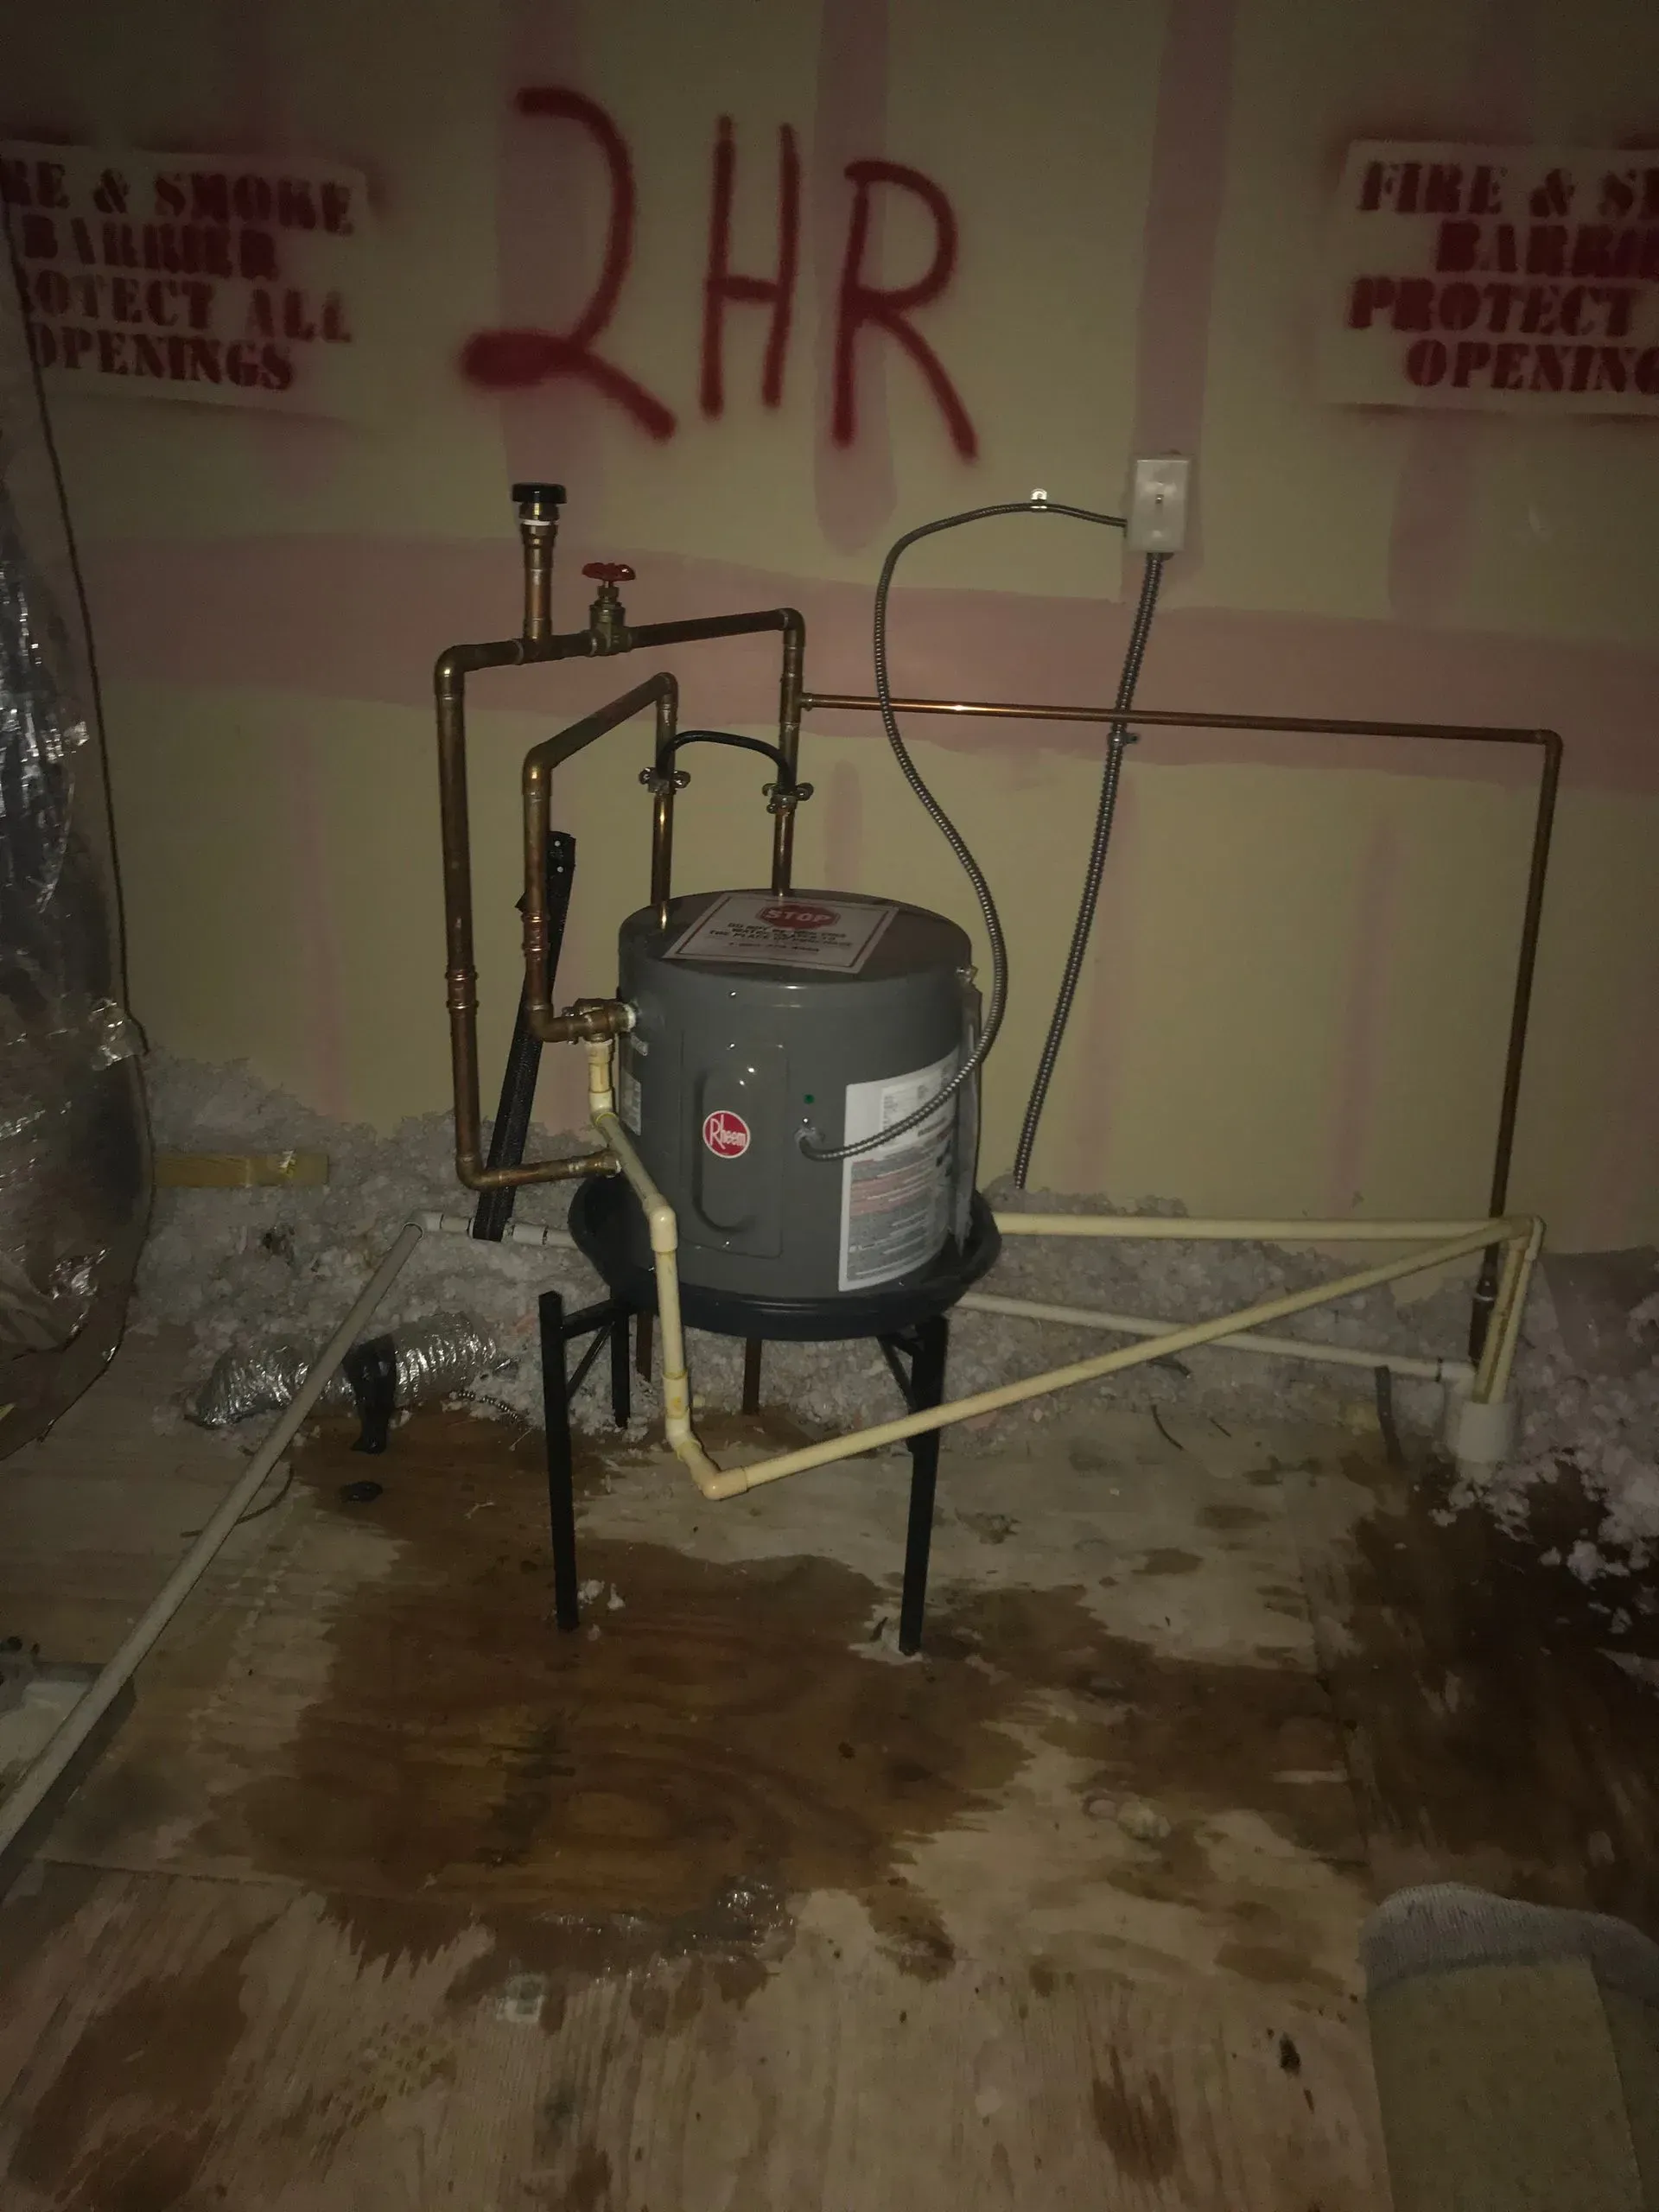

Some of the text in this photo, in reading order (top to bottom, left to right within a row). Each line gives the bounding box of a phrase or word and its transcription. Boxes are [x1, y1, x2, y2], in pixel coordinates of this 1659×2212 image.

[93, 168, 129, 213] &
[155, 172, 353, 236] SMOKE
[1358, 161, 1503, 214] FIRE
[1529, 168, 1575, 217] &
[22, 214, 277, 281] BARRIER
[251, 287, 352, 343] ALL
[1348, 276, 1637, 337] PROTECT
[766, 909, 832, 923] STOP
[709, 1114, 746, 1150] Rheem
